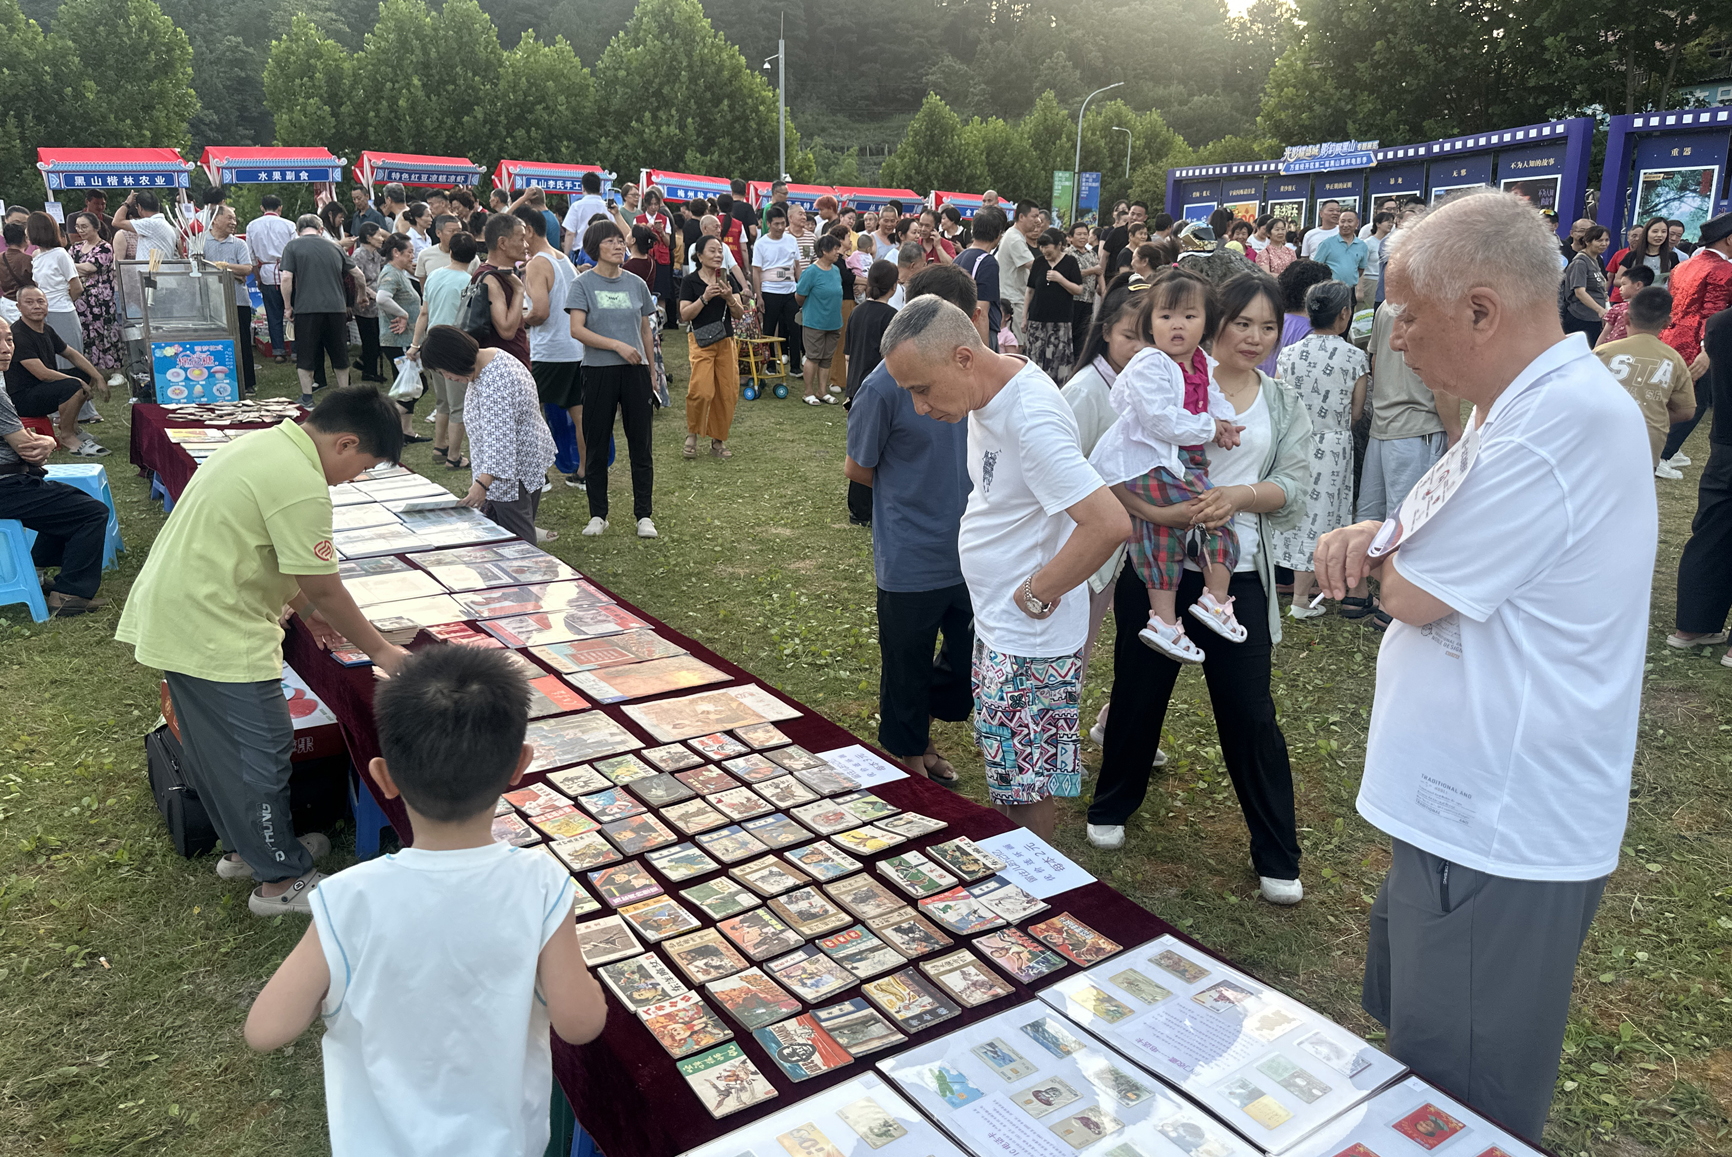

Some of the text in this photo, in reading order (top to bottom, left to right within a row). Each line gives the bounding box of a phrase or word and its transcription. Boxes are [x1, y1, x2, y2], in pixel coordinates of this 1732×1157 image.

[1511, 158, 1555, 169] 不为人知的故事
[258, 170, 309, 181] 水果副食
[391, 171, 466, 183] 特色红豆凉糕凉虾
[1421, 773, 1458, 794] TRADITIONAL
